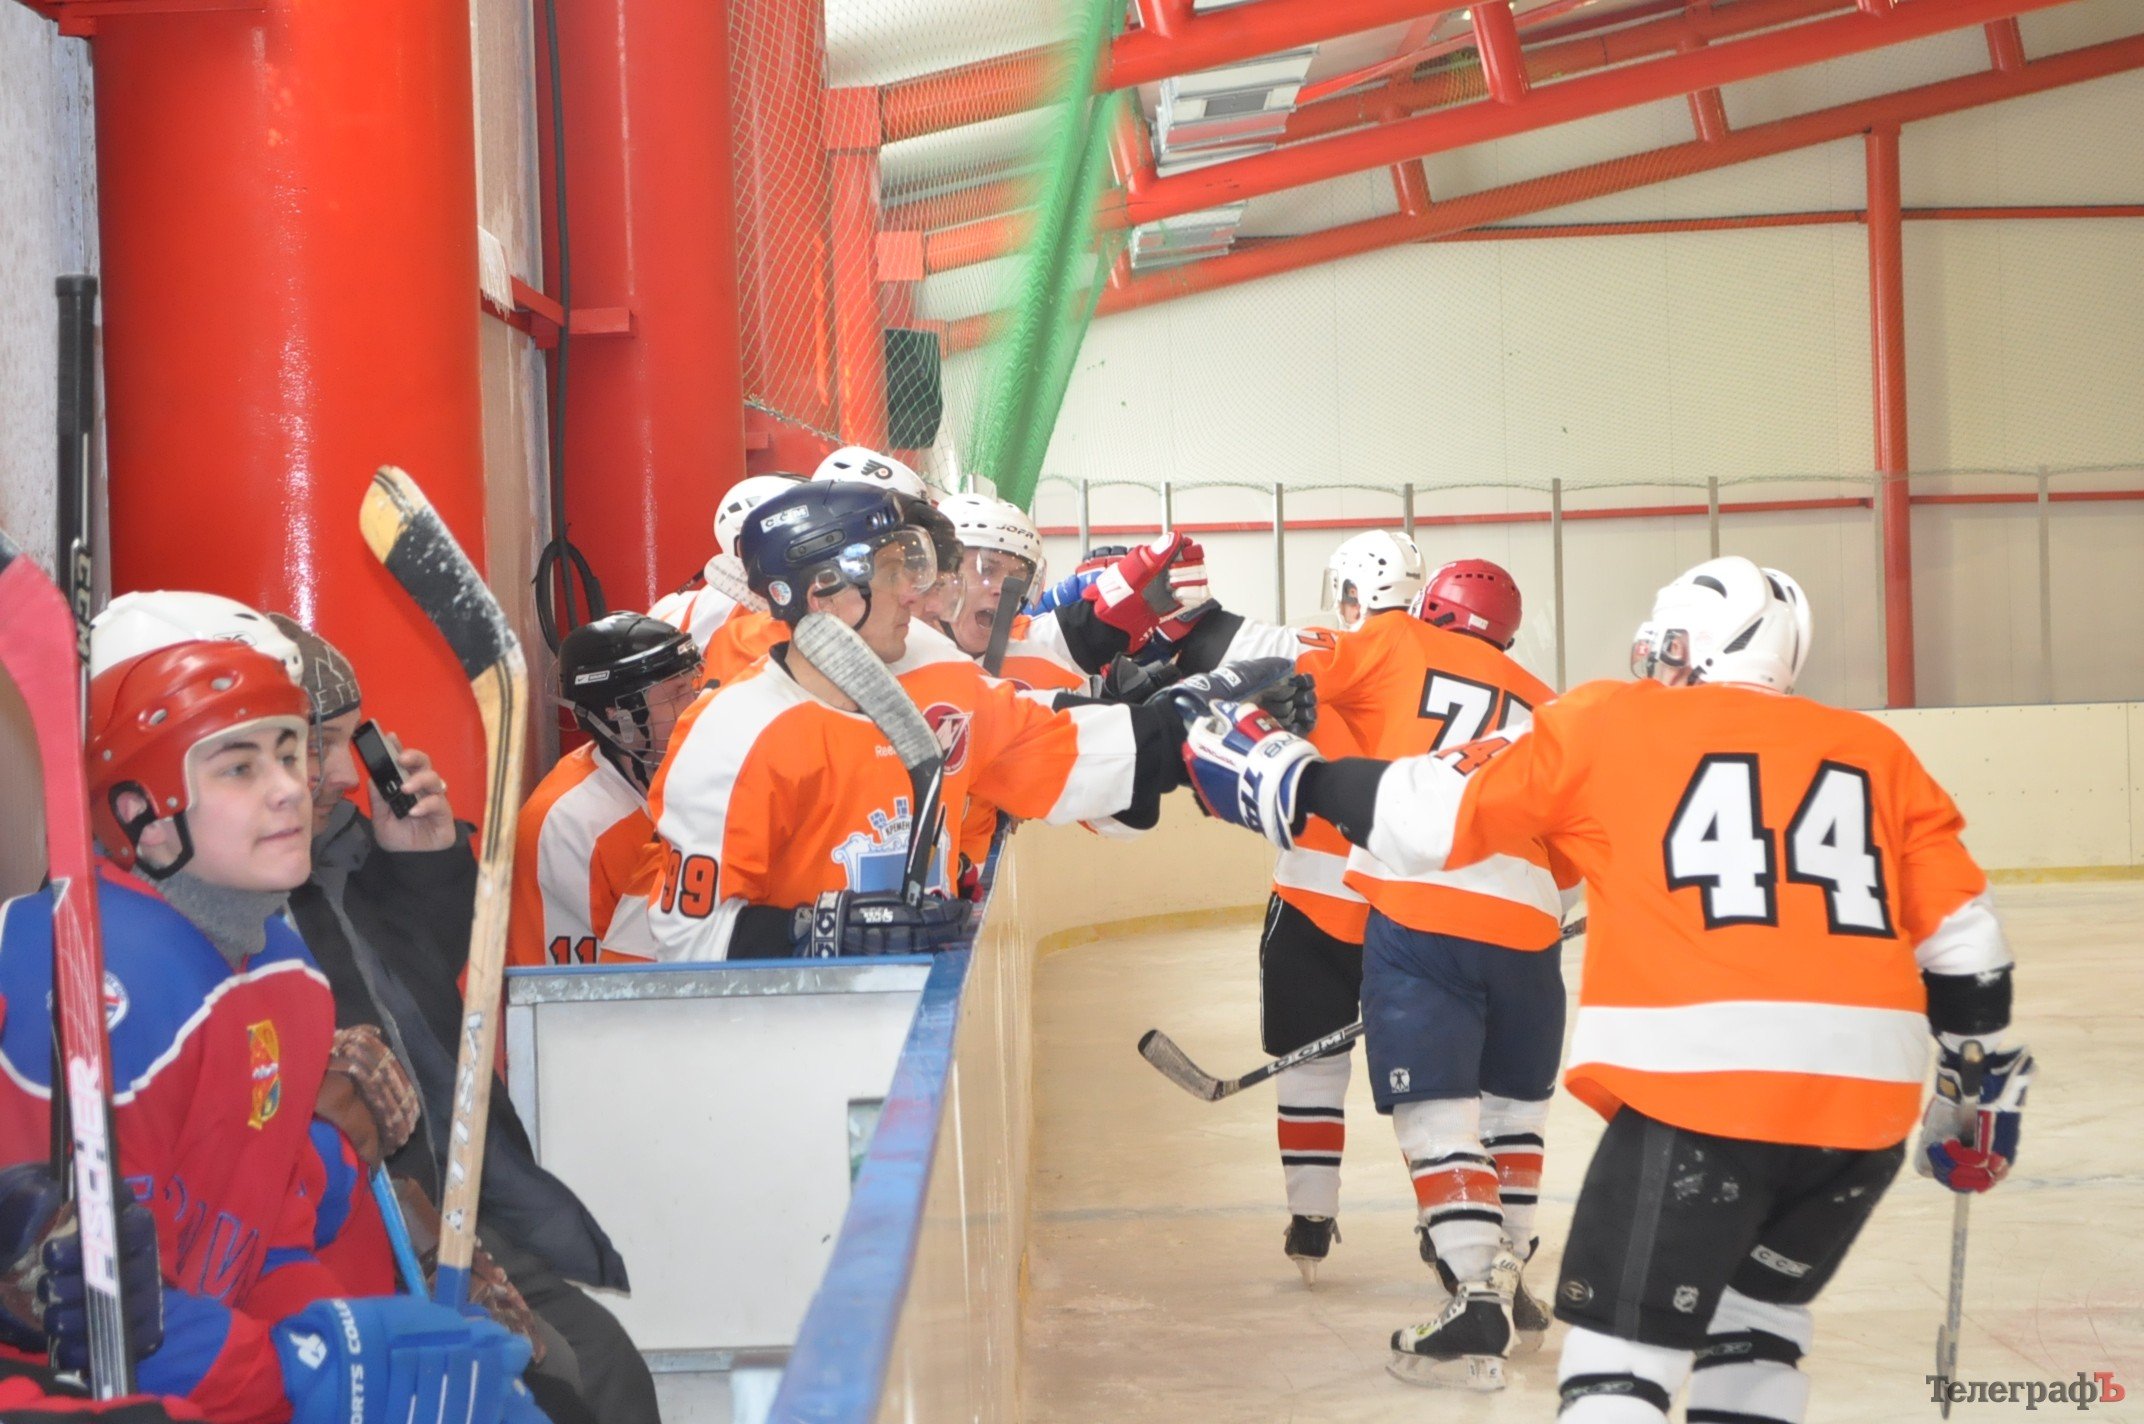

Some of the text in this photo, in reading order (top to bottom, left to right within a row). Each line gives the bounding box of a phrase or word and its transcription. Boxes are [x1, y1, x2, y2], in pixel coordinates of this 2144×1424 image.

[996, 523, 1034, 539] JOFA
[1662, 752, 1898, 939] 44
[1267, 1032, 1343, 1074] CCM
[69, 1055, 118, 1297] FISCHER
